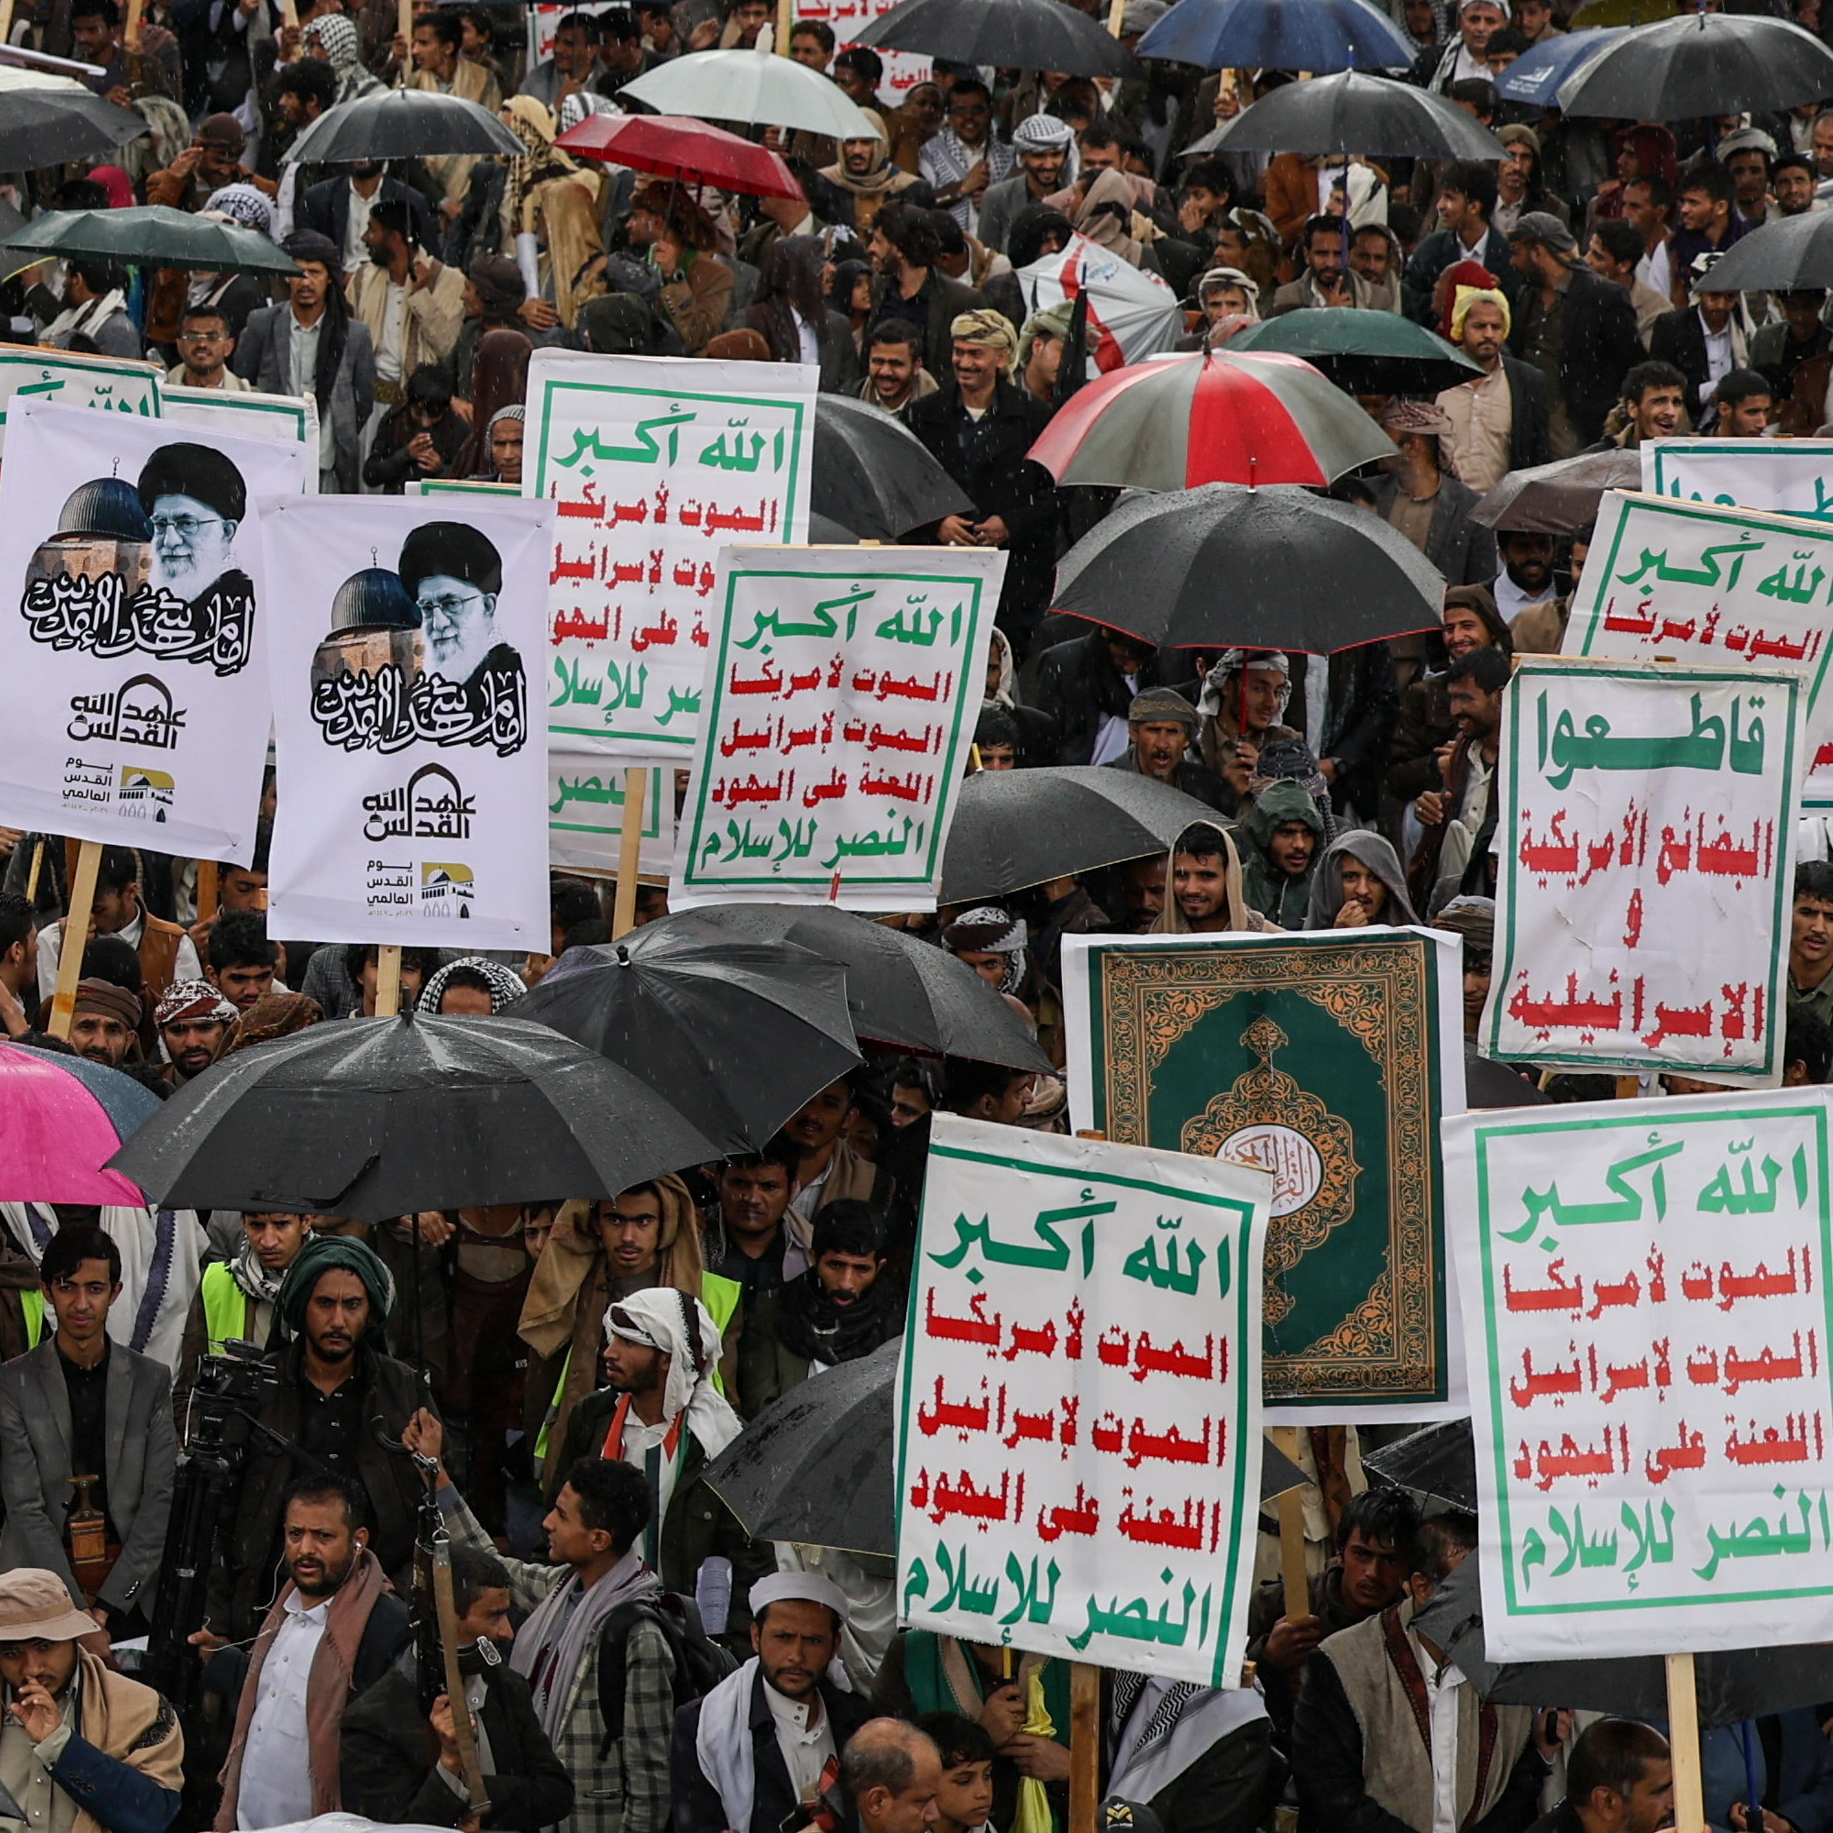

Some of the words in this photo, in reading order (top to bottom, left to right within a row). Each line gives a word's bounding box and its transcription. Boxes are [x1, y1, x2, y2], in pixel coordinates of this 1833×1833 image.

[1537, 689, 1765, 790] قاطعوا
[1519, 797, 1649, 887] الأمريكية
[1656, 806, 1775, 890] البضائع
[1622, 888, 1644, 949] و
[1507, 969, 1766, 1057] الإسرائيلية
[1500, 1132, 1684, 1252] أكبر
[1697, 1140, 1809, 1215] الله
[928, 1189, 1117, 1284] أكبر
[1122, 1218, 1231, 1297] الله
[1503, 1254, 1667, 1321] لأمريكا
[1681, 1246, 1813, 1312] الموت
[925, 1288, 1085, 1362] لأمريكا
[1097, 1326, 1229, 1383] الموت
[1509, 1339, 1673, 1409] لإسرائيل
[1686, 1331, 1819, 1396] الموت
[917, 1376, 1080, 1460] لإسرائيل
[1091, 1412, 1228, 1469] الموت
[1645, 1421, 1708, 1485] على
[1725, 1412, 1825, 1466] اللعنة
[1513, 1425, 1631, 1492] اليهود
[910, 1470, 1026, 1532] اليهود
[1036, 1485, 1101, 1543] على
[1117, 1488, 1221, 1553] اللعنة
[1694, 1485, 1832, 1581] النصر
[1521, 1502, 1675, 1589] للإسلام
[902, 1540, 1061, 1648] للإسلام
[1068, 1568, 1211, 1650] النصر
